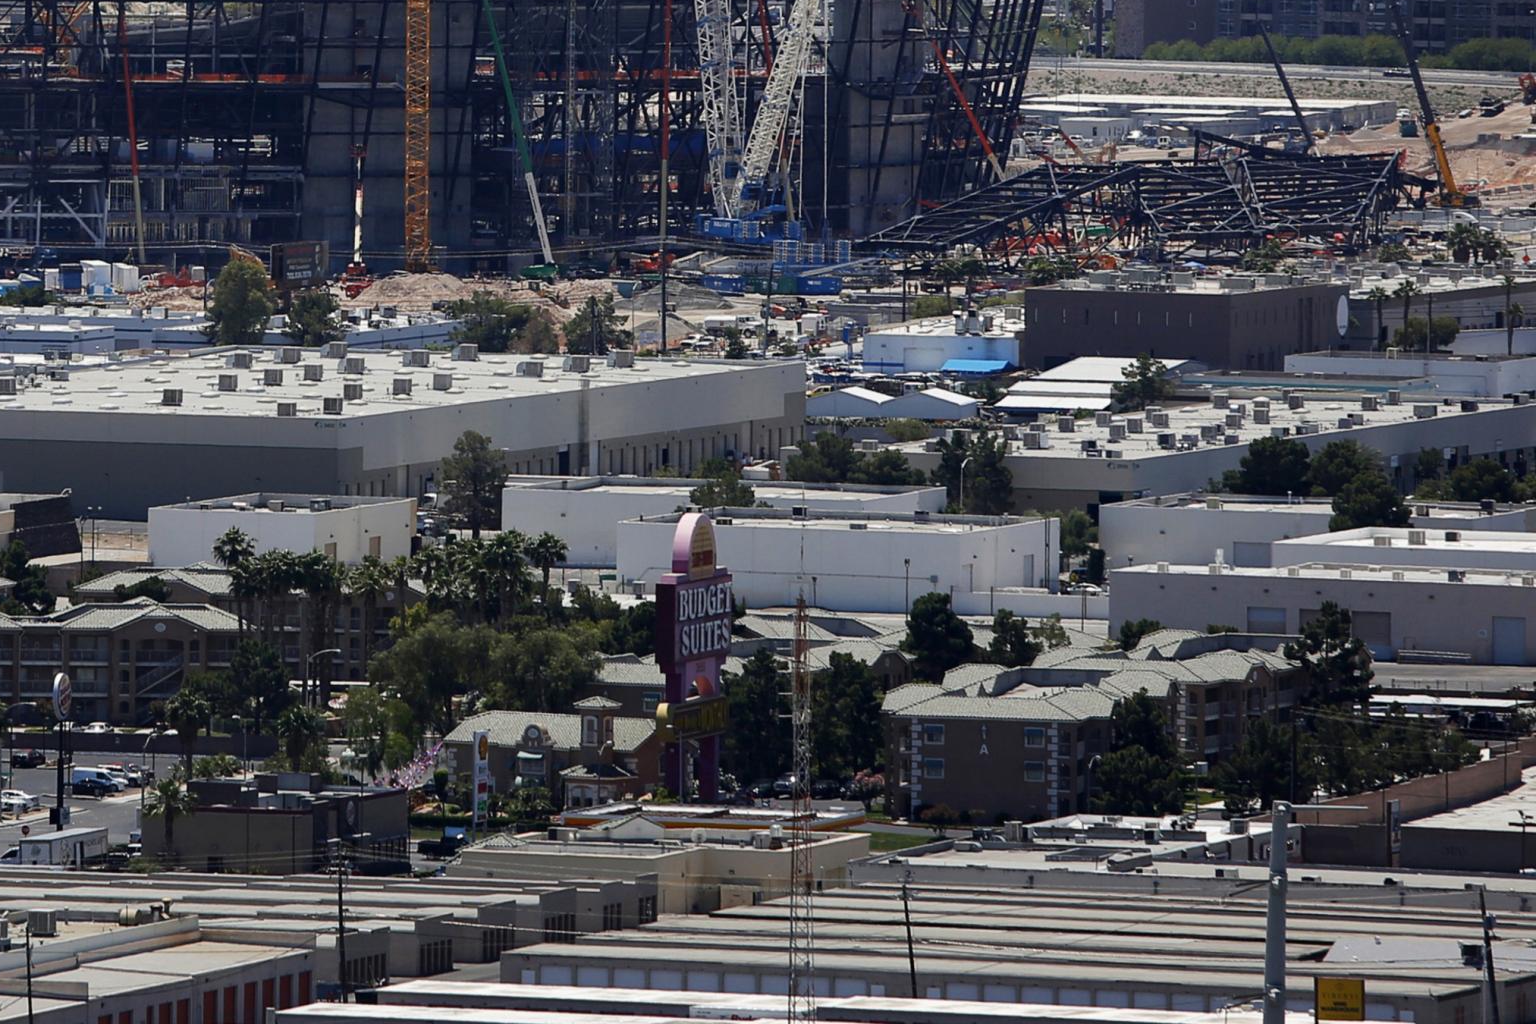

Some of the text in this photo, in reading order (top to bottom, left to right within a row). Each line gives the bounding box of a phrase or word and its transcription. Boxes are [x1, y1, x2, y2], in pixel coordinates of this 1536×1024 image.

[679, 581, 732, 621] BUDGET
[681, 618, 730, 656] SUITES
[979, 744, 989, 754] A
